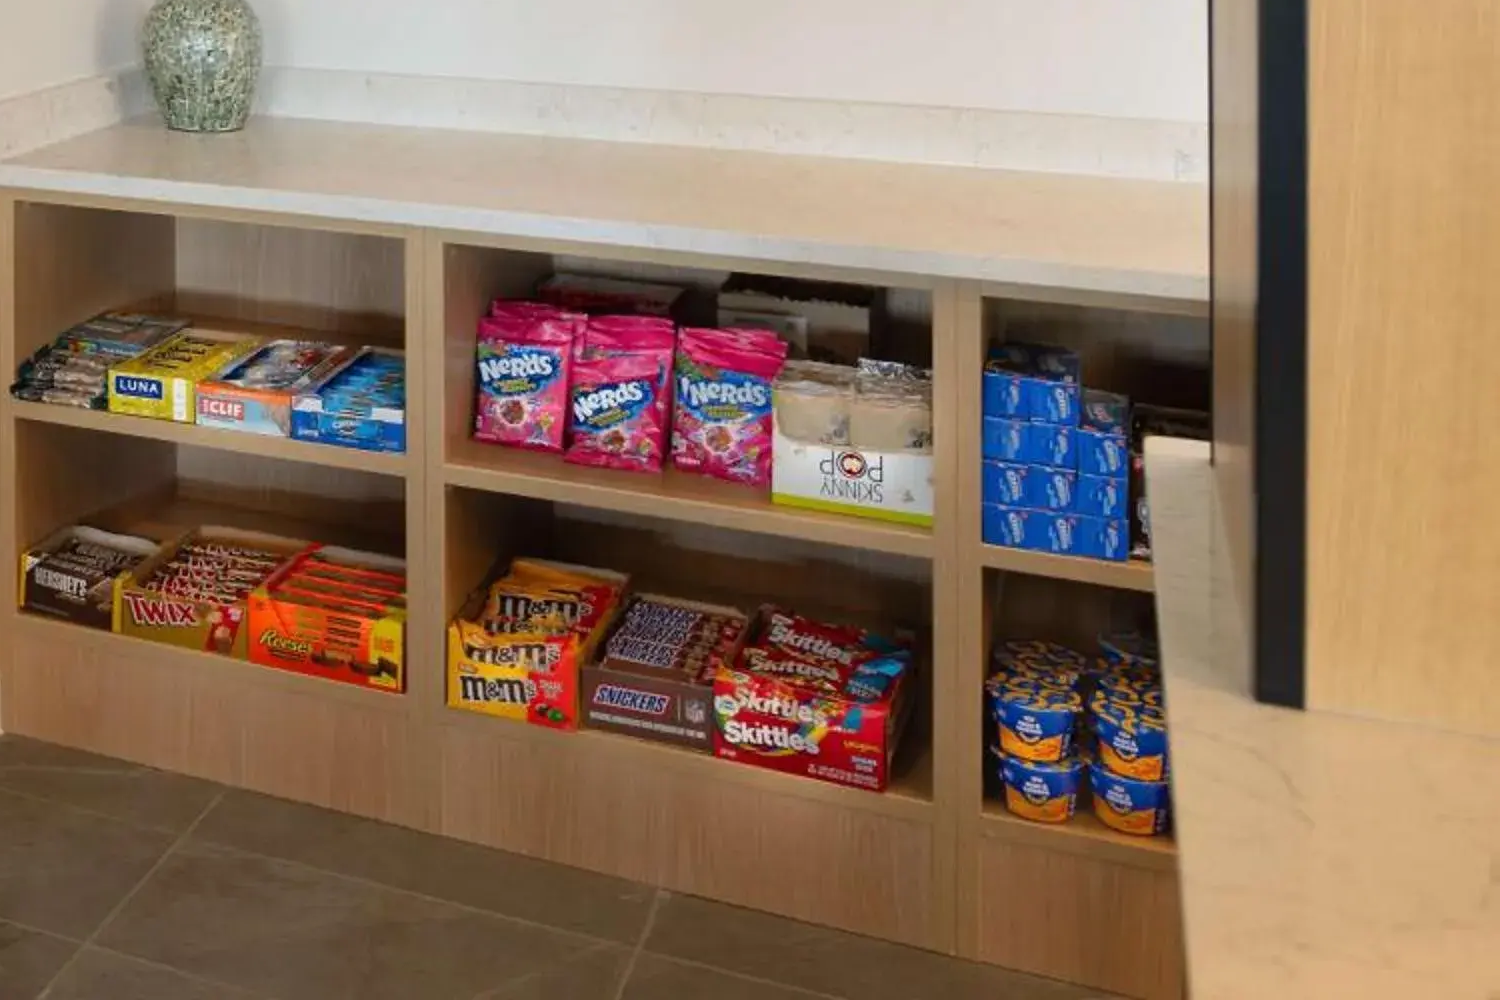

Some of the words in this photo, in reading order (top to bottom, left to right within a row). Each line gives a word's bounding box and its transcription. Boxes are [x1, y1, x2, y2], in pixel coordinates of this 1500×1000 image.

[119, 379, 159, 395] LUNA
[820, 450, 883, 483] POP
[820, 477, 883, 503] SKINNY
[35, 566, 88, 597] HERSHEY'S
[122, 589, 197, 625] TWIX
[769, 624, 852, 665] Skittles
[596, 685, 668, 714] SNICKERS
[723, 721, 820, 755] Skittles
